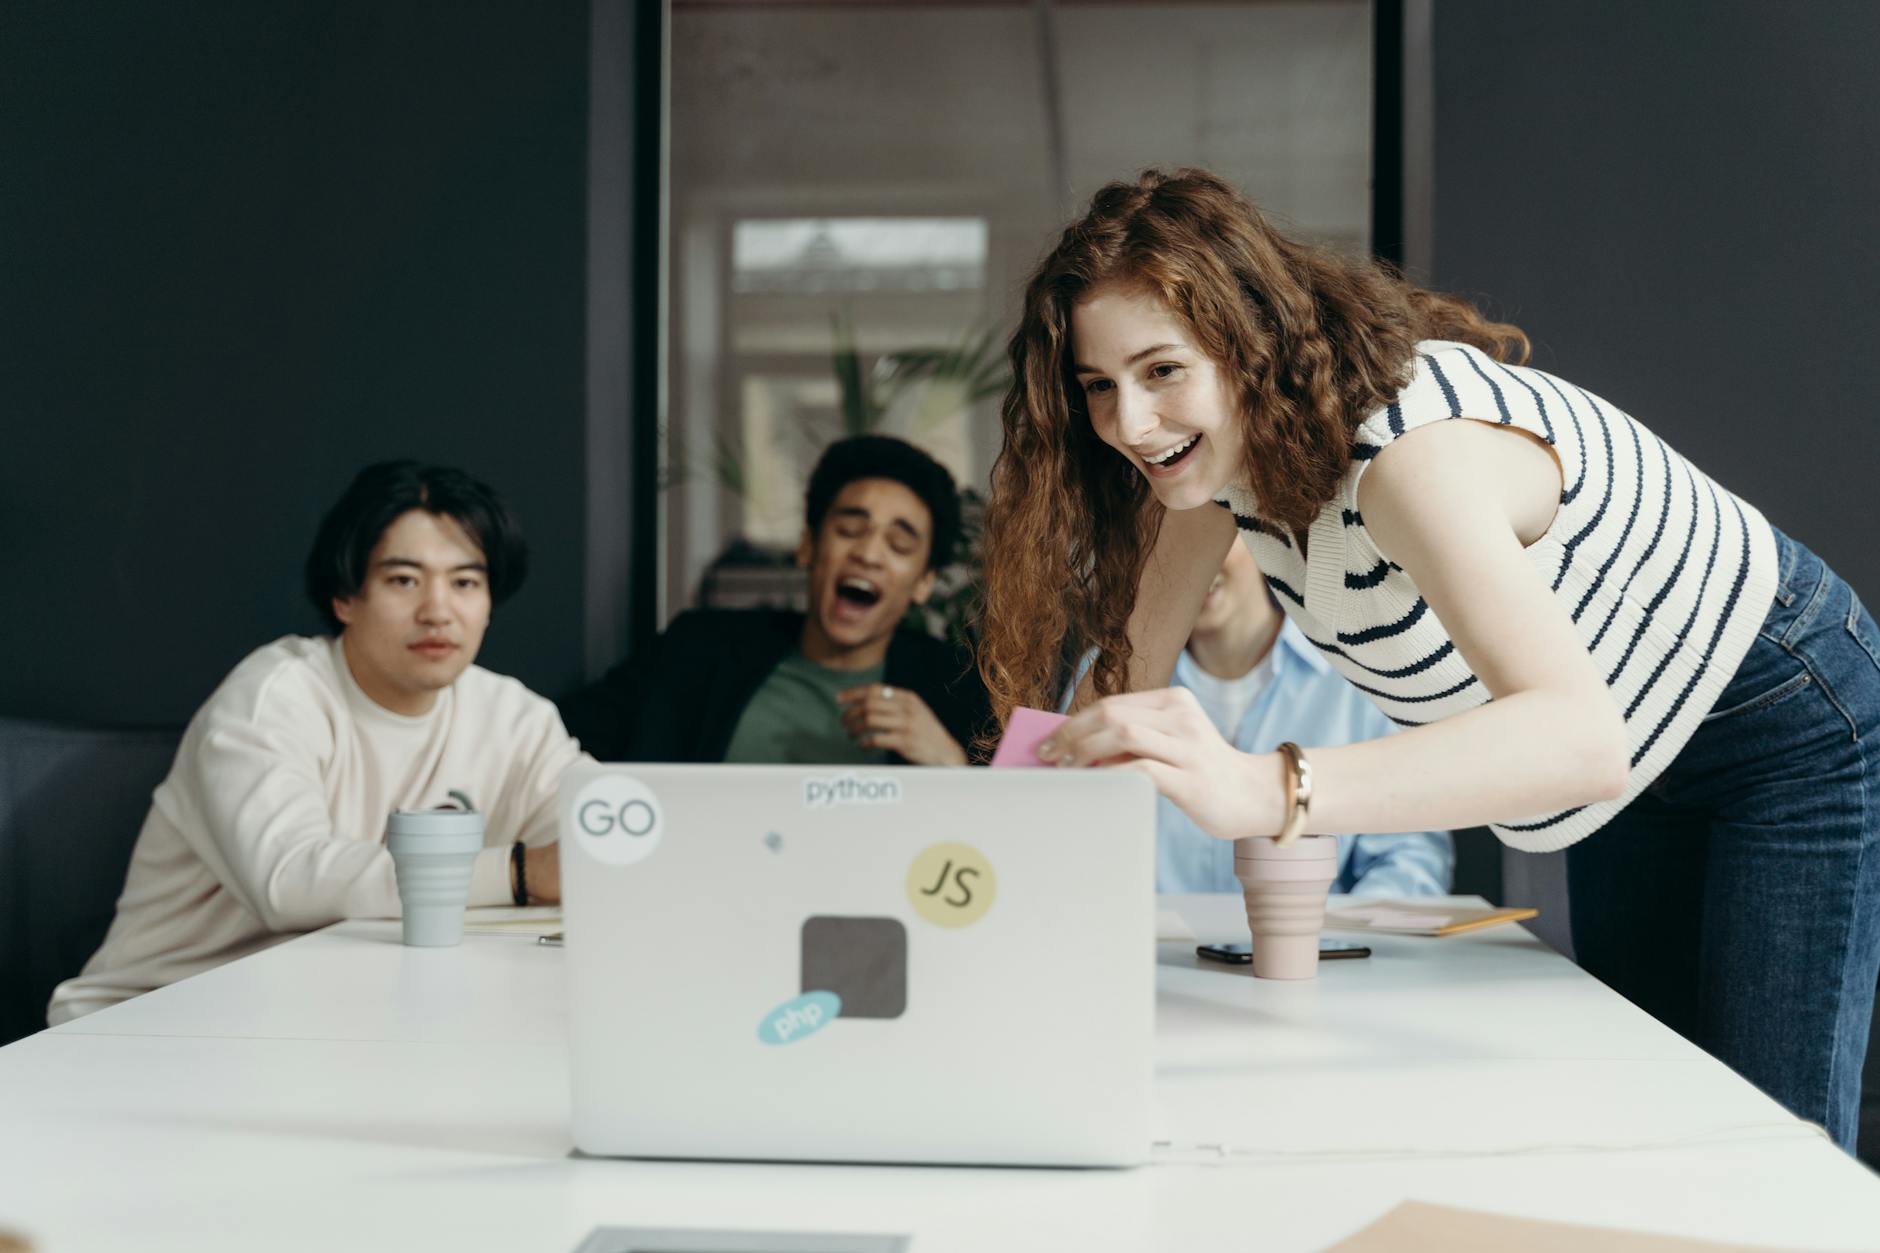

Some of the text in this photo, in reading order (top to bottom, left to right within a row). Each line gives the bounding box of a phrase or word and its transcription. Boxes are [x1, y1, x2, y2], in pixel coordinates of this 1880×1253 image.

[806, 777, 898, 802] python
[578, 799, 656, 836] GO
[920, 860, 980, 908] JS
[774, 1001, 822, 1040] php
